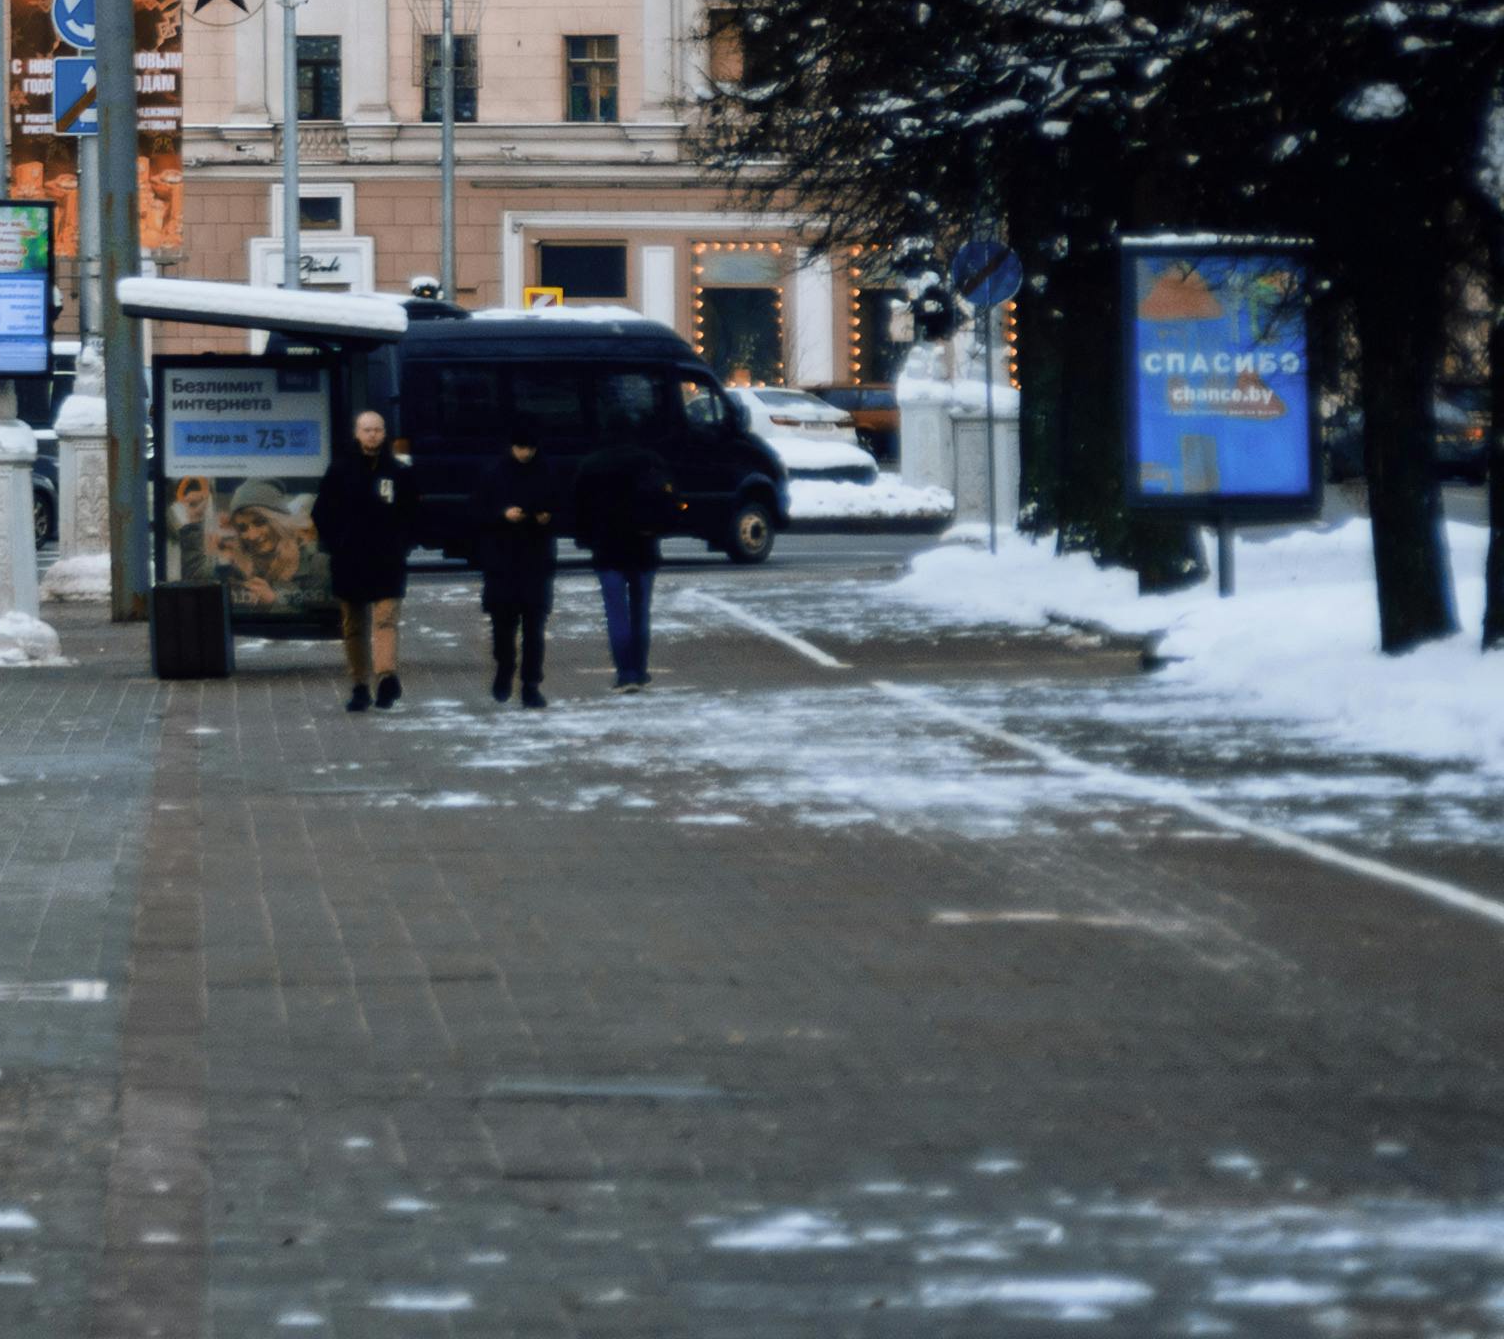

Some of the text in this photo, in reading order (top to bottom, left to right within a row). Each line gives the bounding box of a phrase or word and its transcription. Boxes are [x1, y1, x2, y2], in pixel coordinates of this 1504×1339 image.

[11, 58, 55, 75] С НОВ
[22, 78, 54, 95] ГОДО
[1144, 351, 1301, 374] СПАСИБО
[171, 378, 264, 394] Безлимит
[1172, 384, 1274, 405] chance.by
[171, 398, 273, 414] интернета
[255, 428, 287, 450] 7,5
